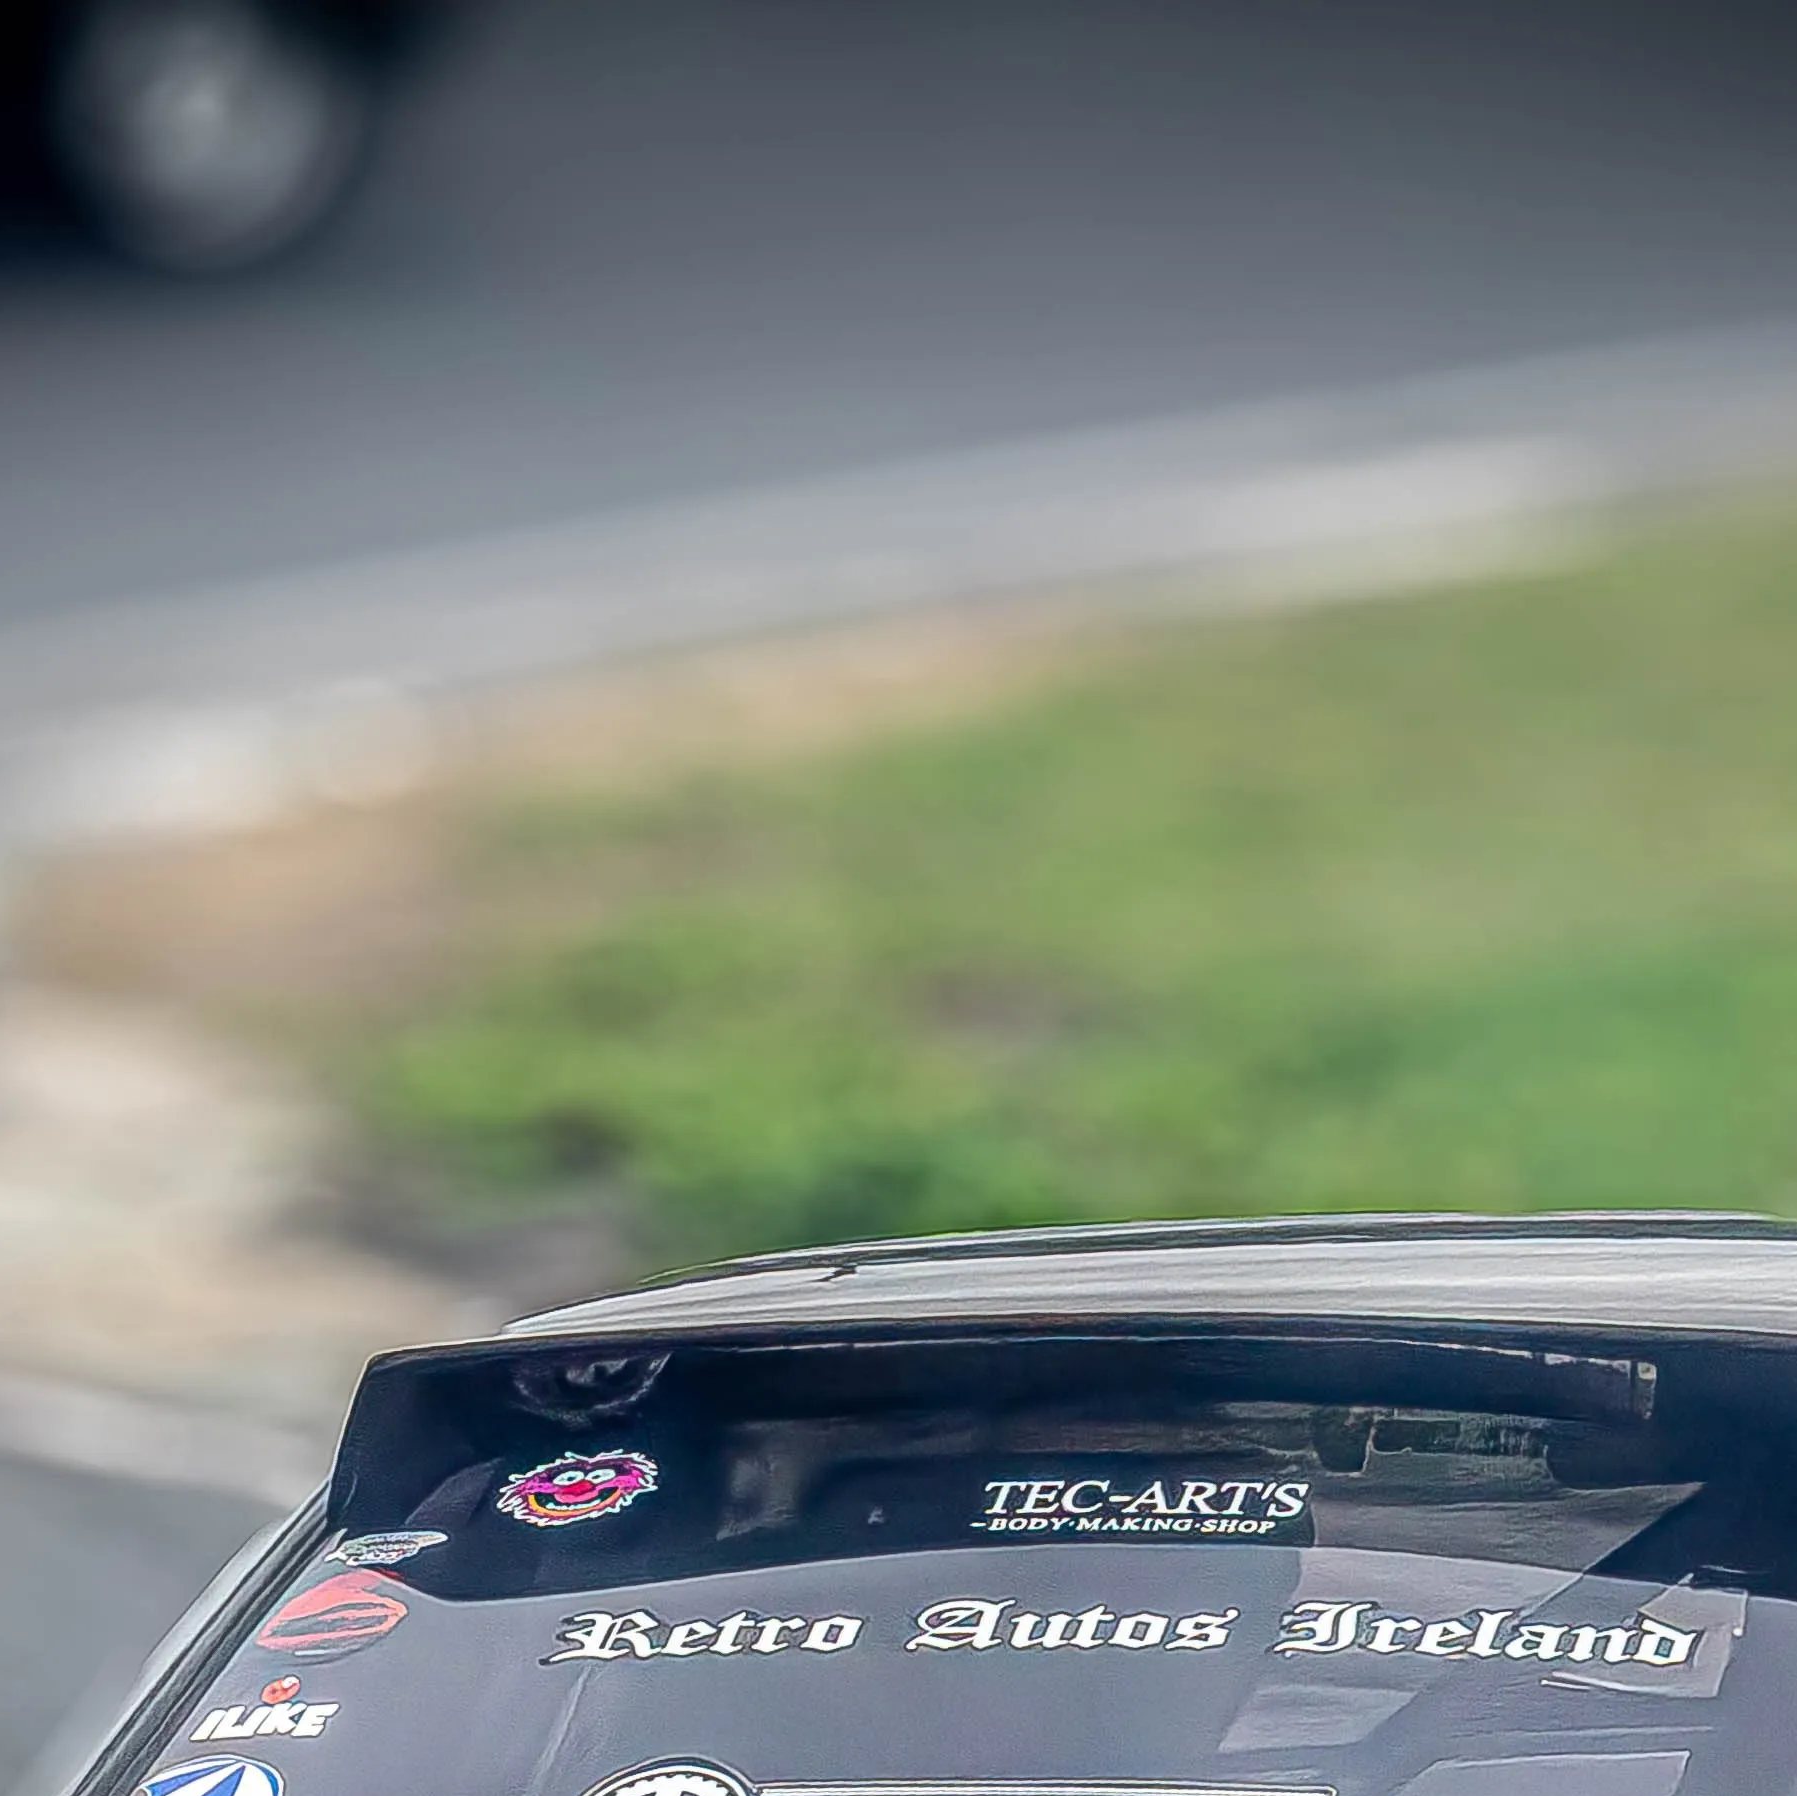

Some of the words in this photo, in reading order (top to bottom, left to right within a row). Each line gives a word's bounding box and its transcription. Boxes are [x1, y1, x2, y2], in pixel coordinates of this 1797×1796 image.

[985, 1479, 1309, 1518] TEC-ART'S
[538, 1610, 864, 1667] Retro
[905, 1597, 1240, 1654] Autos
[1274, 1600, 1698, 1668] Ireland
